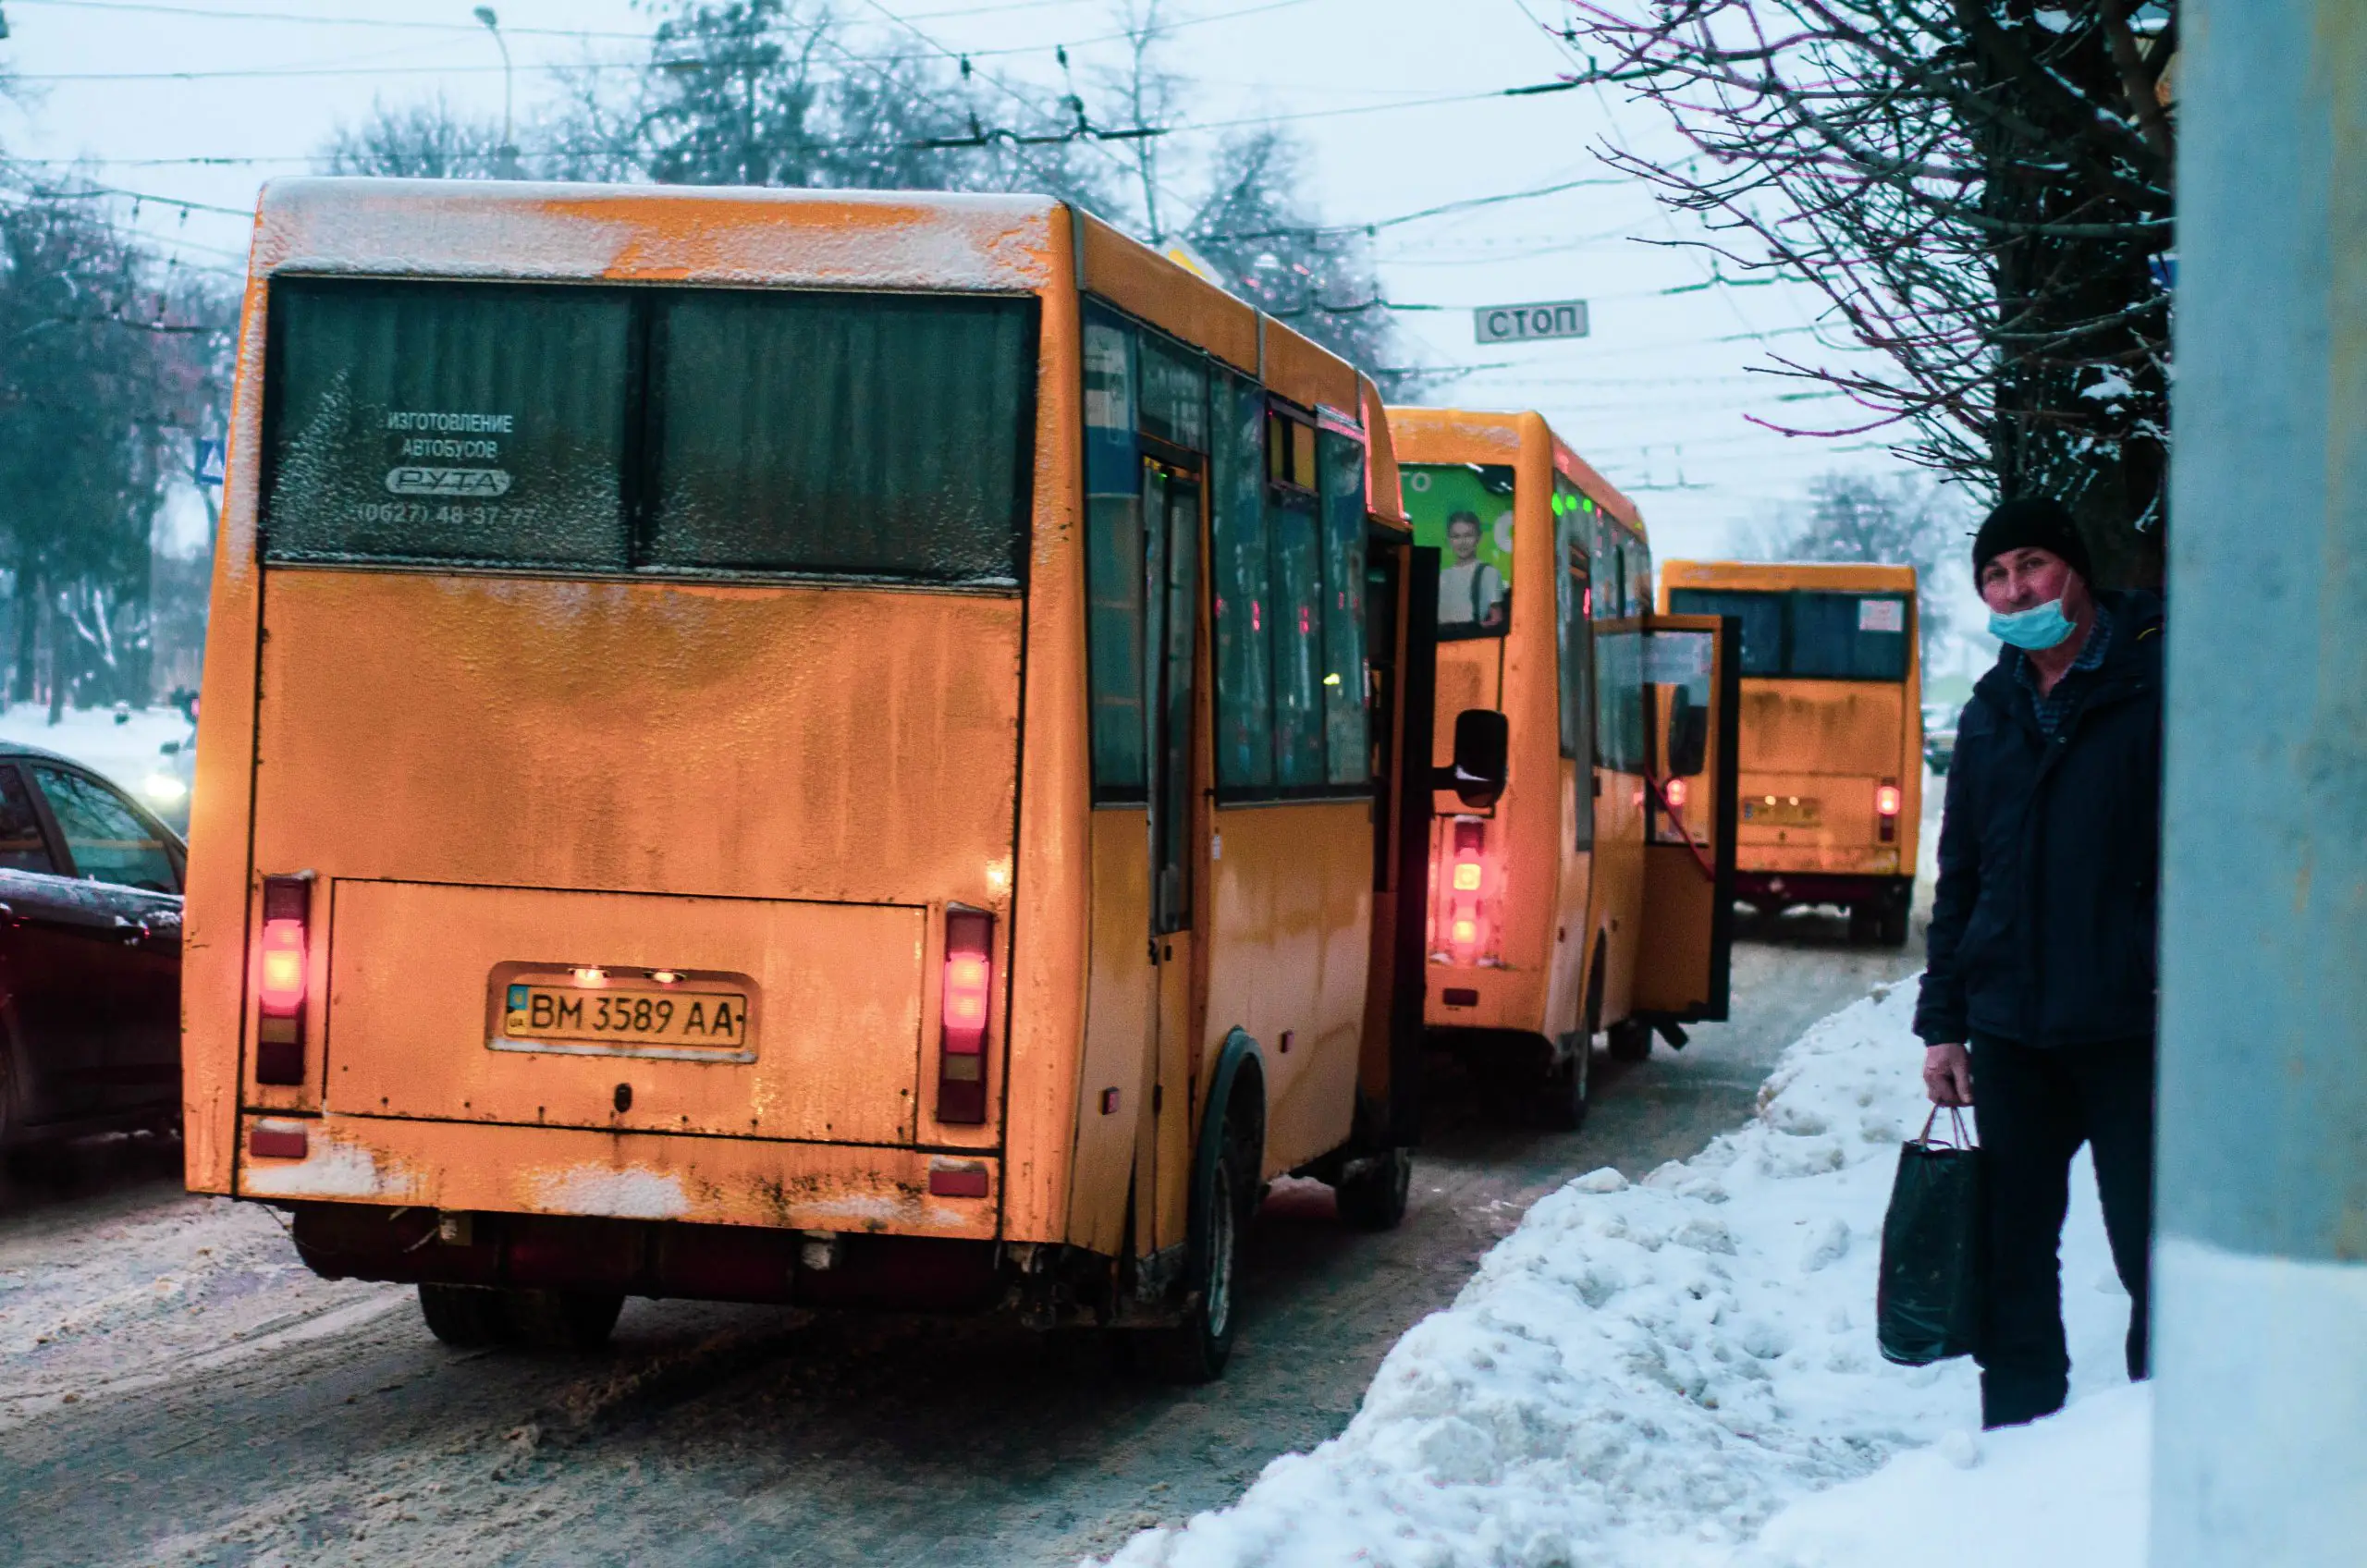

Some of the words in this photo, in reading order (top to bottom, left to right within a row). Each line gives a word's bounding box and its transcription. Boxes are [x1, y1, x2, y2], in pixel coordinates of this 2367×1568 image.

[1487, 306, 1577, 337] СТОП
[386, 411, 514, 434] ИЗГОТОВЛЕНИЕ
[401, 438, 498, 460] АВТОБУСОВ
[396, 470, 499, 493] РУТА
[530, 993, 583, 1030] BM
[591, 997, 675, 1035] 3589
[683, 1000, 734, 1037] AA
